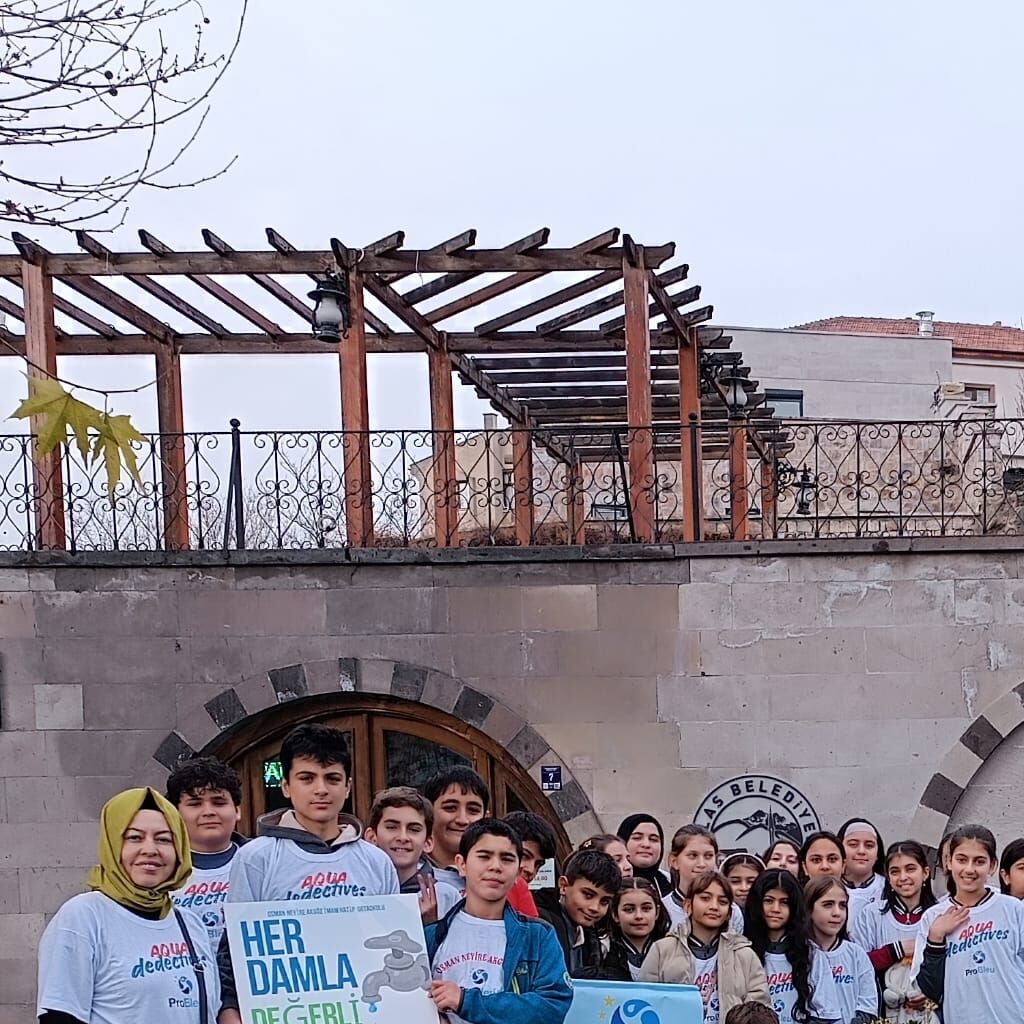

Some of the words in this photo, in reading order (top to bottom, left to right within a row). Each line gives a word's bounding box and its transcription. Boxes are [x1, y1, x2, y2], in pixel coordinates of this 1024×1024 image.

[729, 780, 817, 833] BELEDİYE
[301, 872, 347, 889] AQUA
[240, 918, 305, 957] HER
[959, 920, 993, 942] AQUA
[435, 955, 460, 974] OSMAN
[965, 967, 995, 977] ProBleu
[246, 953, 359, 997] DAMLA
[168, 997, 200, 1009] ProBle
